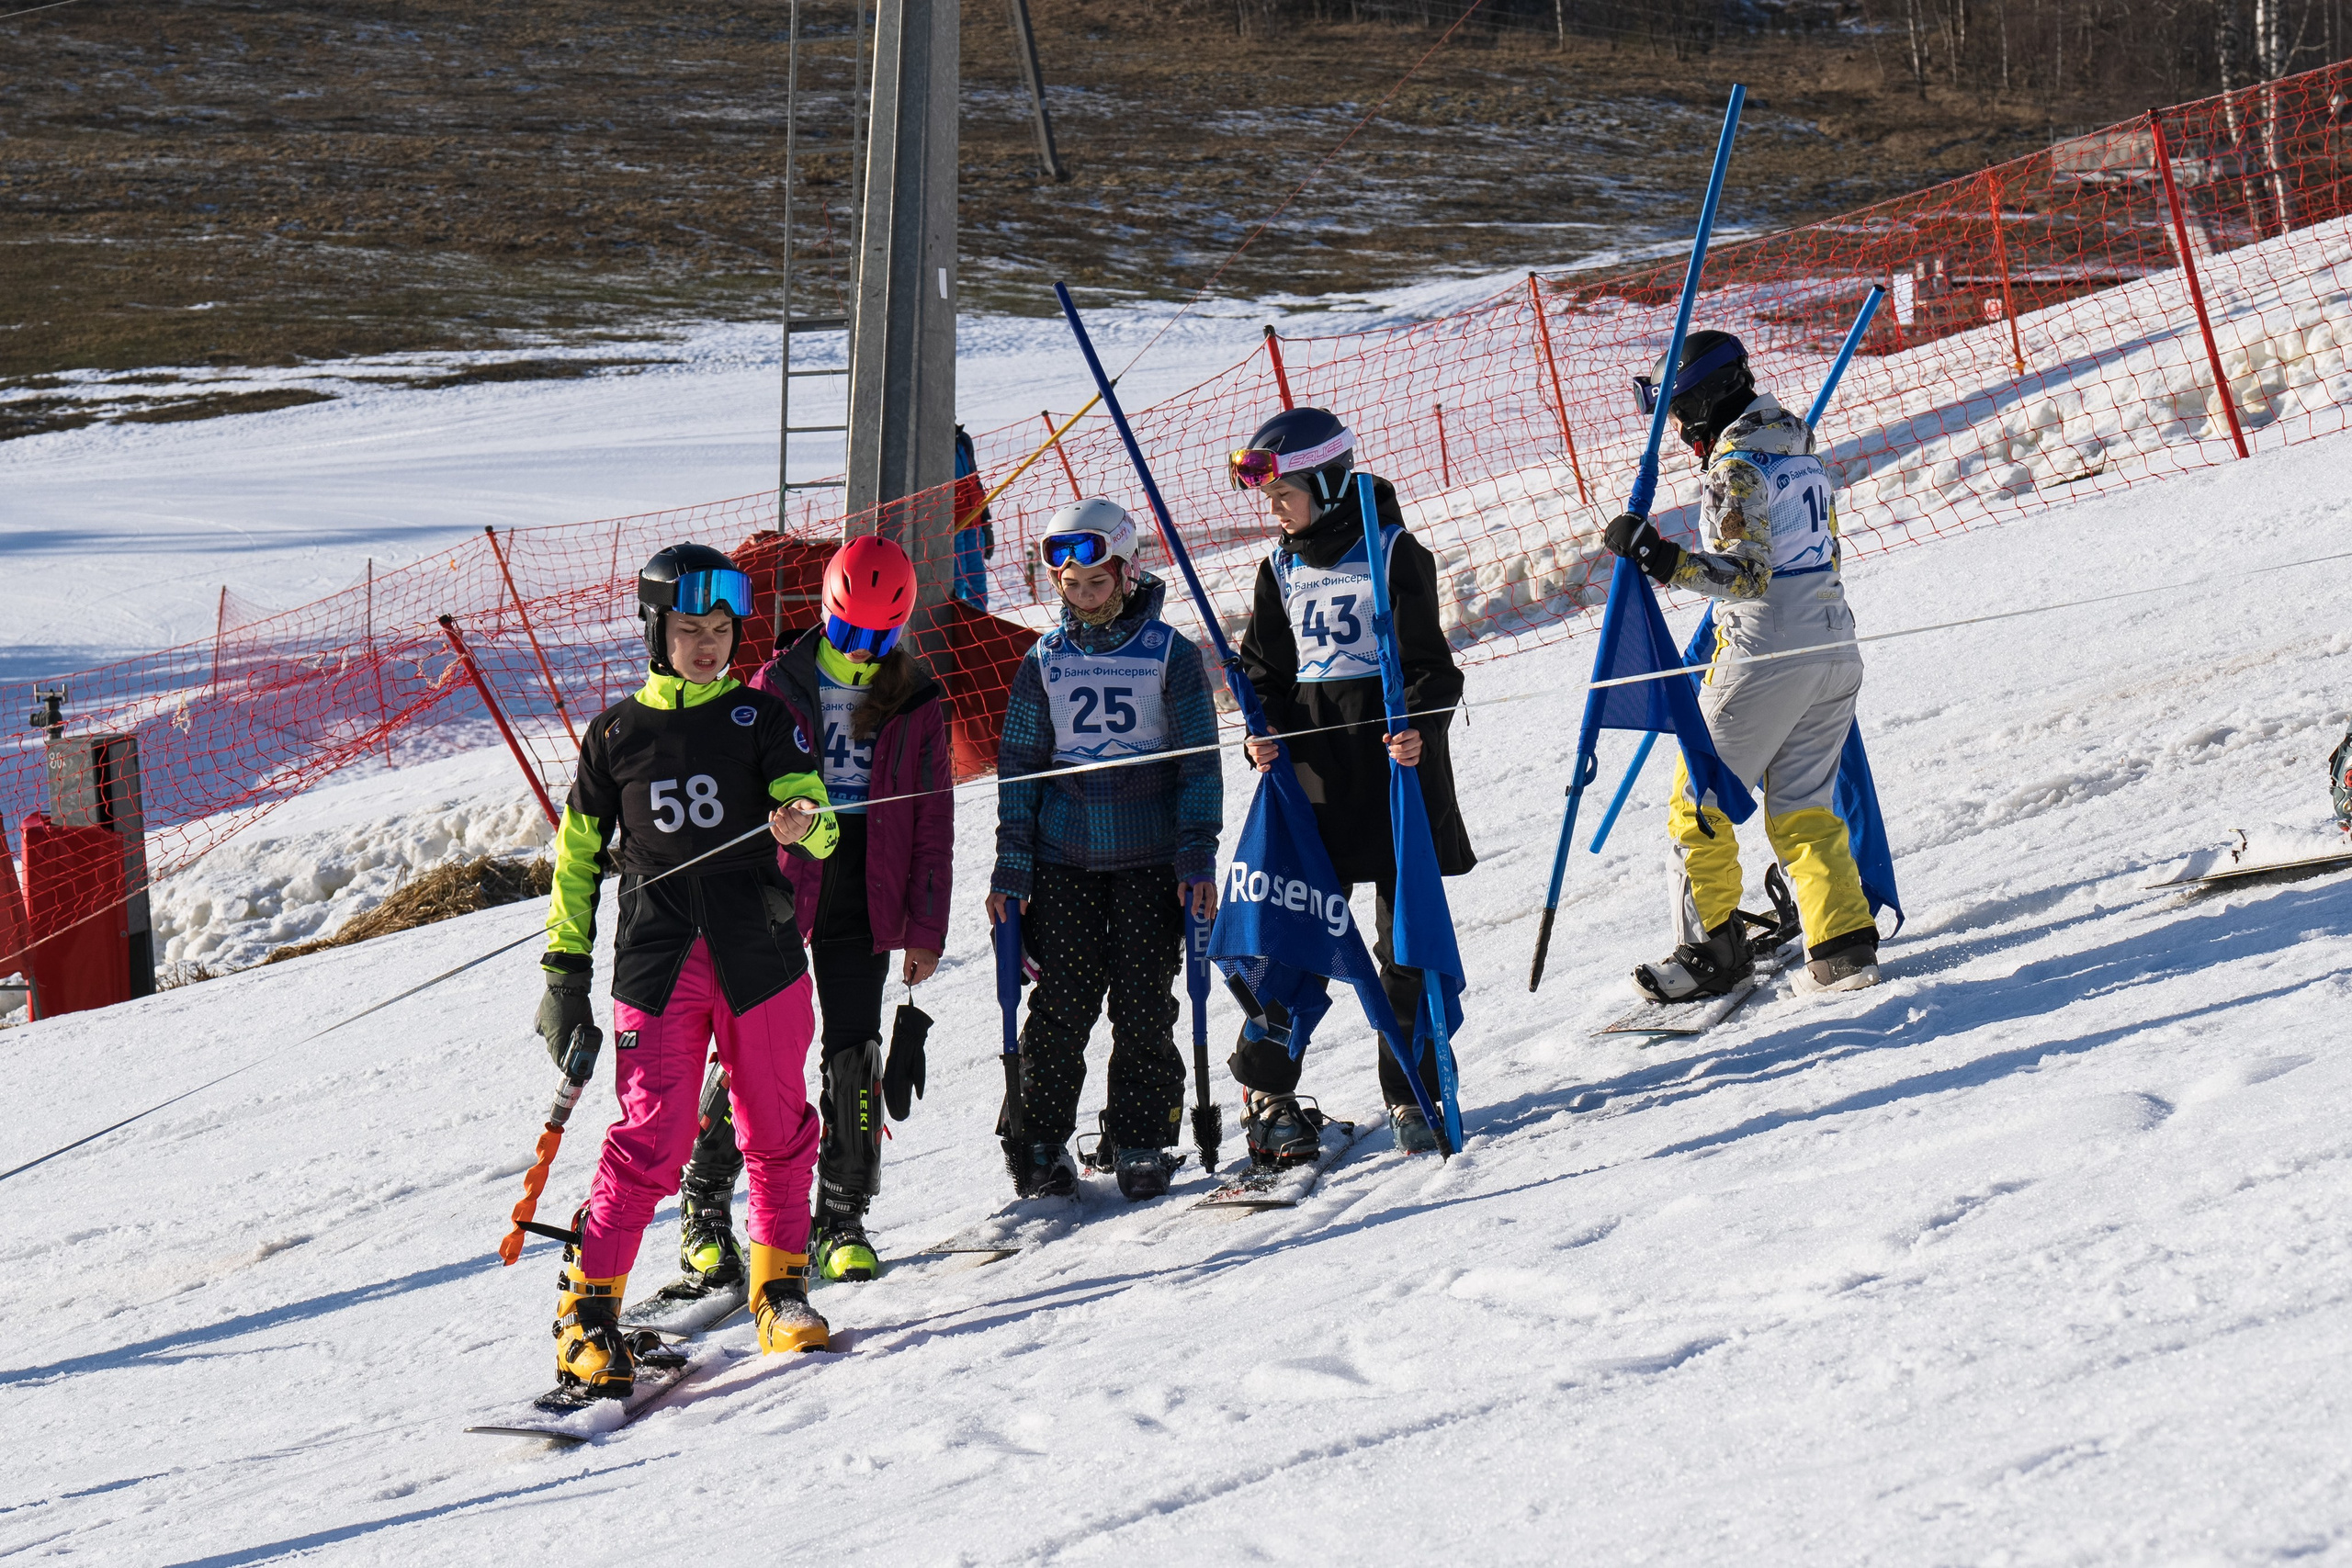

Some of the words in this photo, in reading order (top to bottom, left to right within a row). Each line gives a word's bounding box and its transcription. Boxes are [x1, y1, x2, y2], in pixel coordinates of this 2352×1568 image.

[1288, 437, 1343, 468] SALICE
[1113, 526, 1127, 543] ROXY
[1295, 580, 1319, 591] Банк
[1302, 594, 1363, 646] 43
[1064, 667, 1091, 678] Банк
[1092, 667, 1158, 679] Финсервис
[820, 703, 843, 711] Банк
[1069, 687, 1136, 733] 25
[824, 722, 876, 769] 45
[650, 773, 724, 833] 58
[1229, 861, 1358, 937] Roseng
[859, 1089, 868, 1131] LEKI
